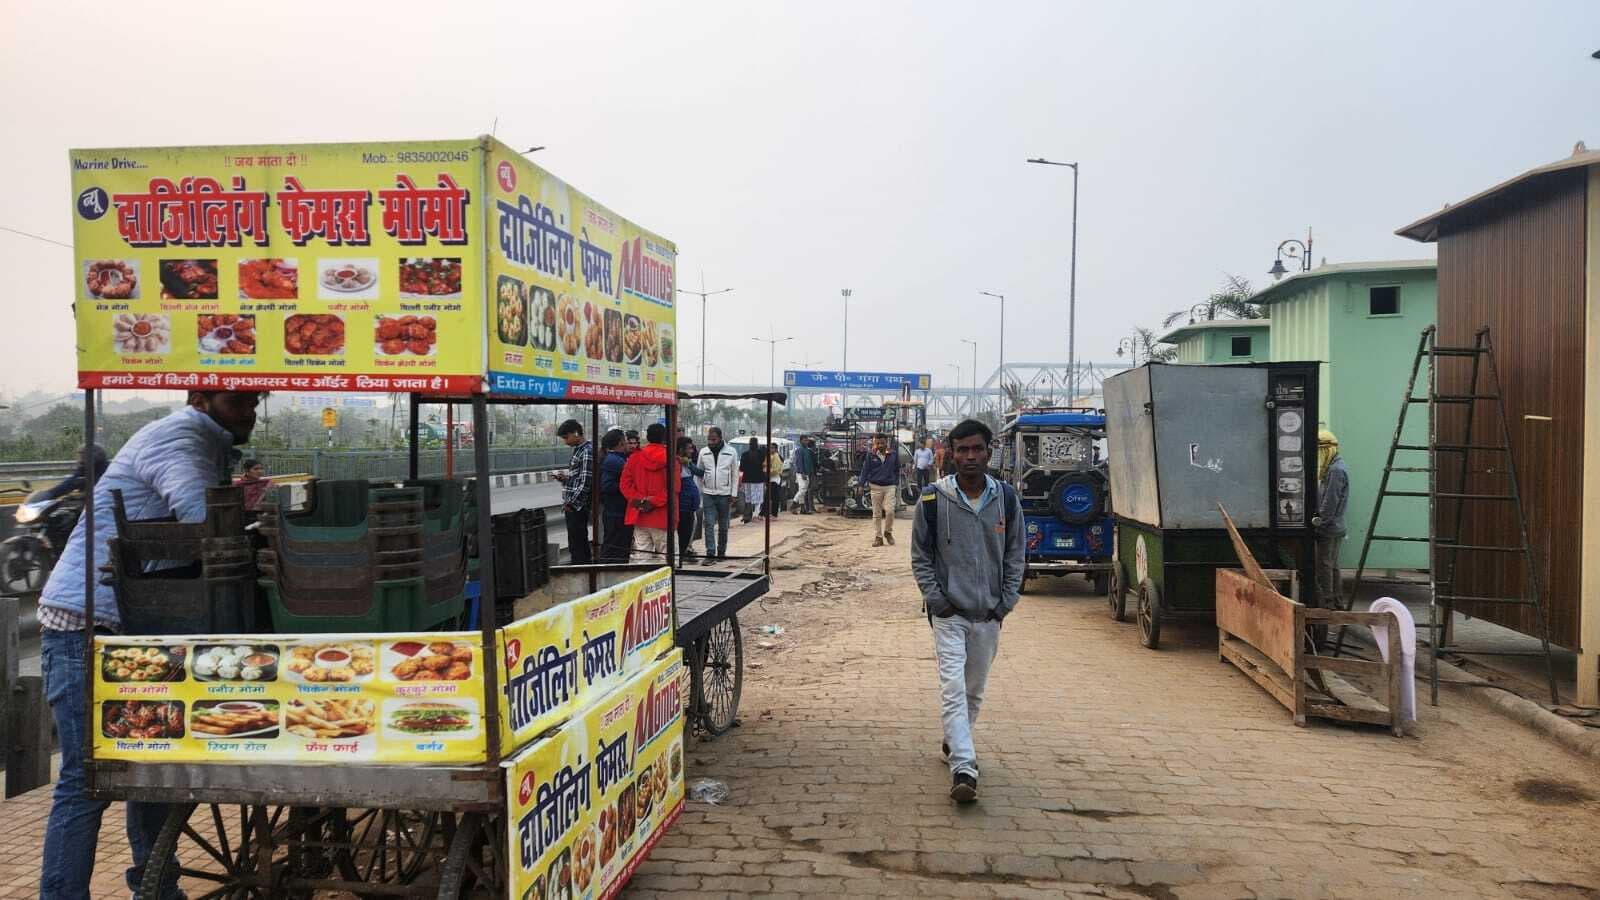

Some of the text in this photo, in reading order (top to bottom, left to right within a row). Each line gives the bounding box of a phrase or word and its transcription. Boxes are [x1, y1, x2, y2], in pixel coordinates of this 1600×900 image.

[74, 158, 108, 170] Marine
[234, 155, 253, 167] जय
[257, 154, 282, 167] माता
[286, 153, 297, 166] दी
[396, 151, 469, 163] 9835002046
[113, 173, 468, 246] दार्जिलिंग फेमस मोमो
[496, 194, 575, 283] दार्जिलिंग
[578, 227, 613, 296] फेमस
[102, 373, 133, 386] हमारे
[137, 373, 164, 386] यहाँ
[165, 373, 198, 386] किसी
[202, 373, 218, 386] भी
[292, 377, 309, 389] पर
[312, 375, 349, 389] ऑर्डर
[356, 375, 388, 388] लिया
[393, 376, 427, 389] जाता
[496, 376, 526, 391] Extra
[528, 379, 545, 394] Fry
[581, 630, 616, 686] फेमस
[207, 683, 234, 694] पनीर
[243, 741, 267, 751] रोल
[416, 741, 444, 751] बर्गर
[518, 754, 591, 869] दार्जिलिंग
[595, 731, 628, 795] फेमस
